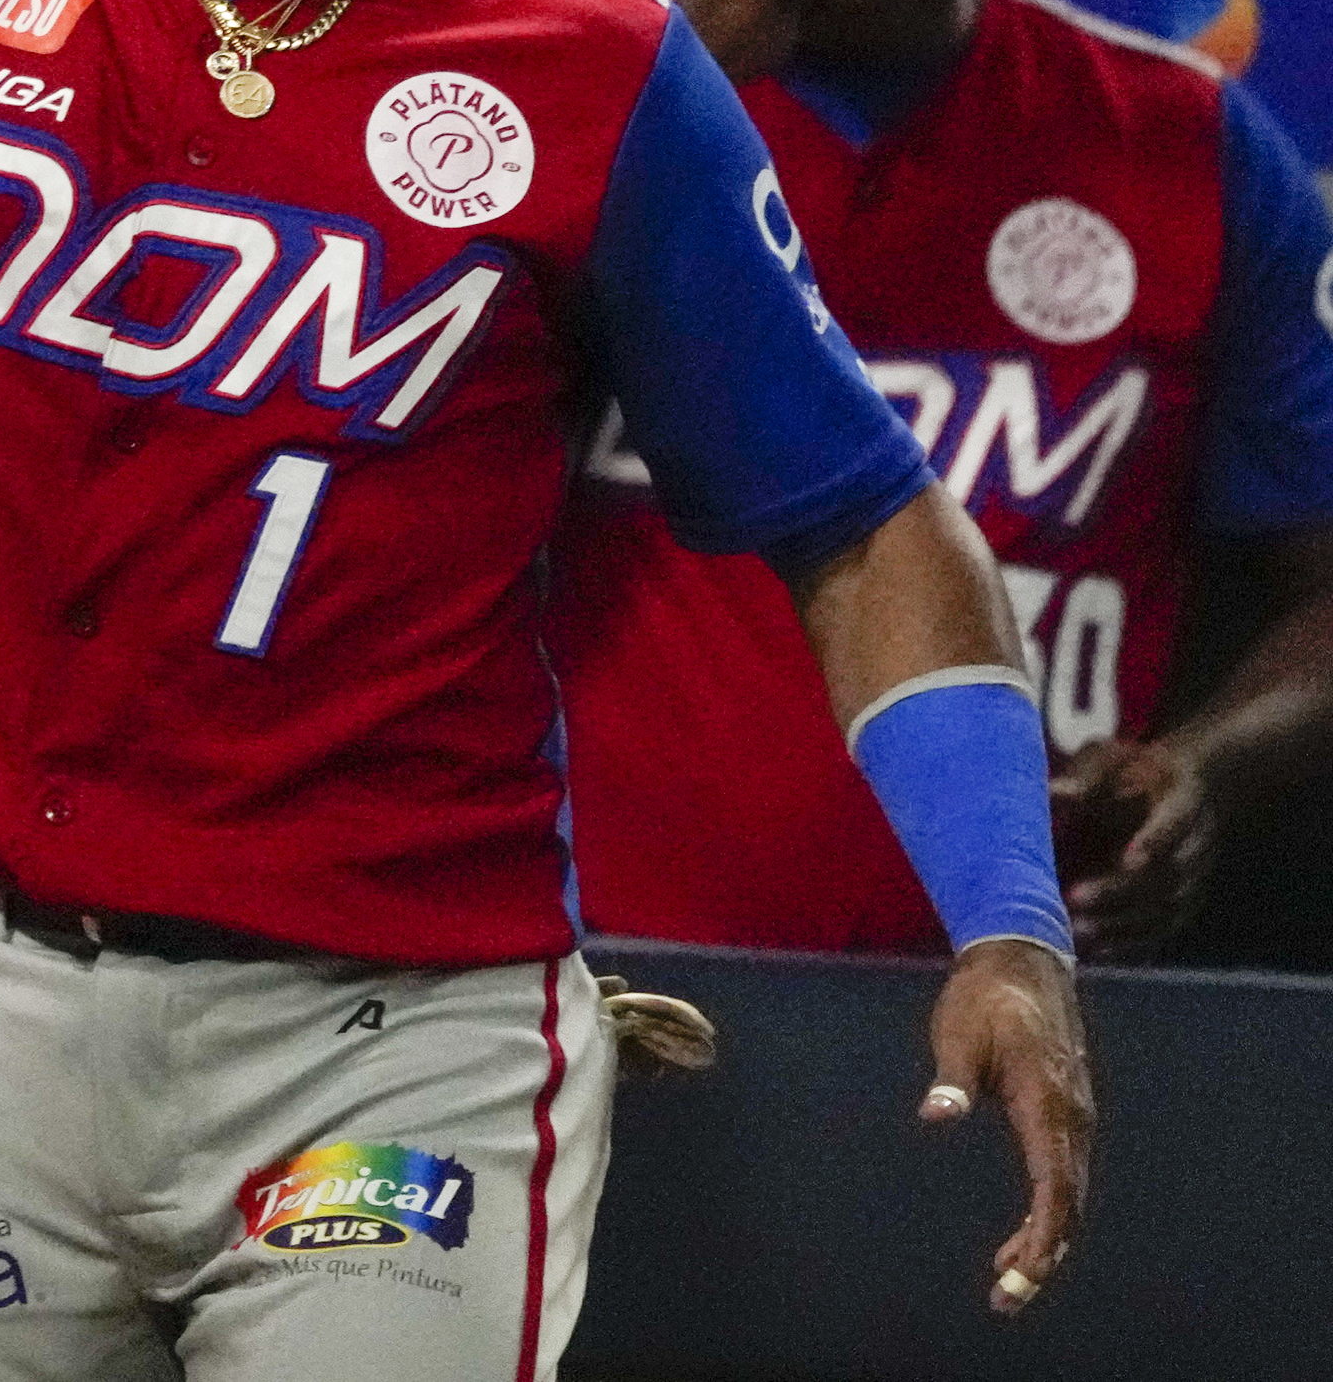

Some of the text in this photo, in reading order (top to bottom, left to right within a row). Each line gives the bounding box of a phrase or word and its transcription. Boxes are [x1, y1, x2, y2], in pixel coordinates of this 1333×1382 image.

[391, 171, 499, 219] POWER
[213, 450, 333, 654] 1
[289, 1220, 383, 1246] PLUS
[327, 1259, 370, 1283] que
[377, 1258, 464, 1299] Pintura
